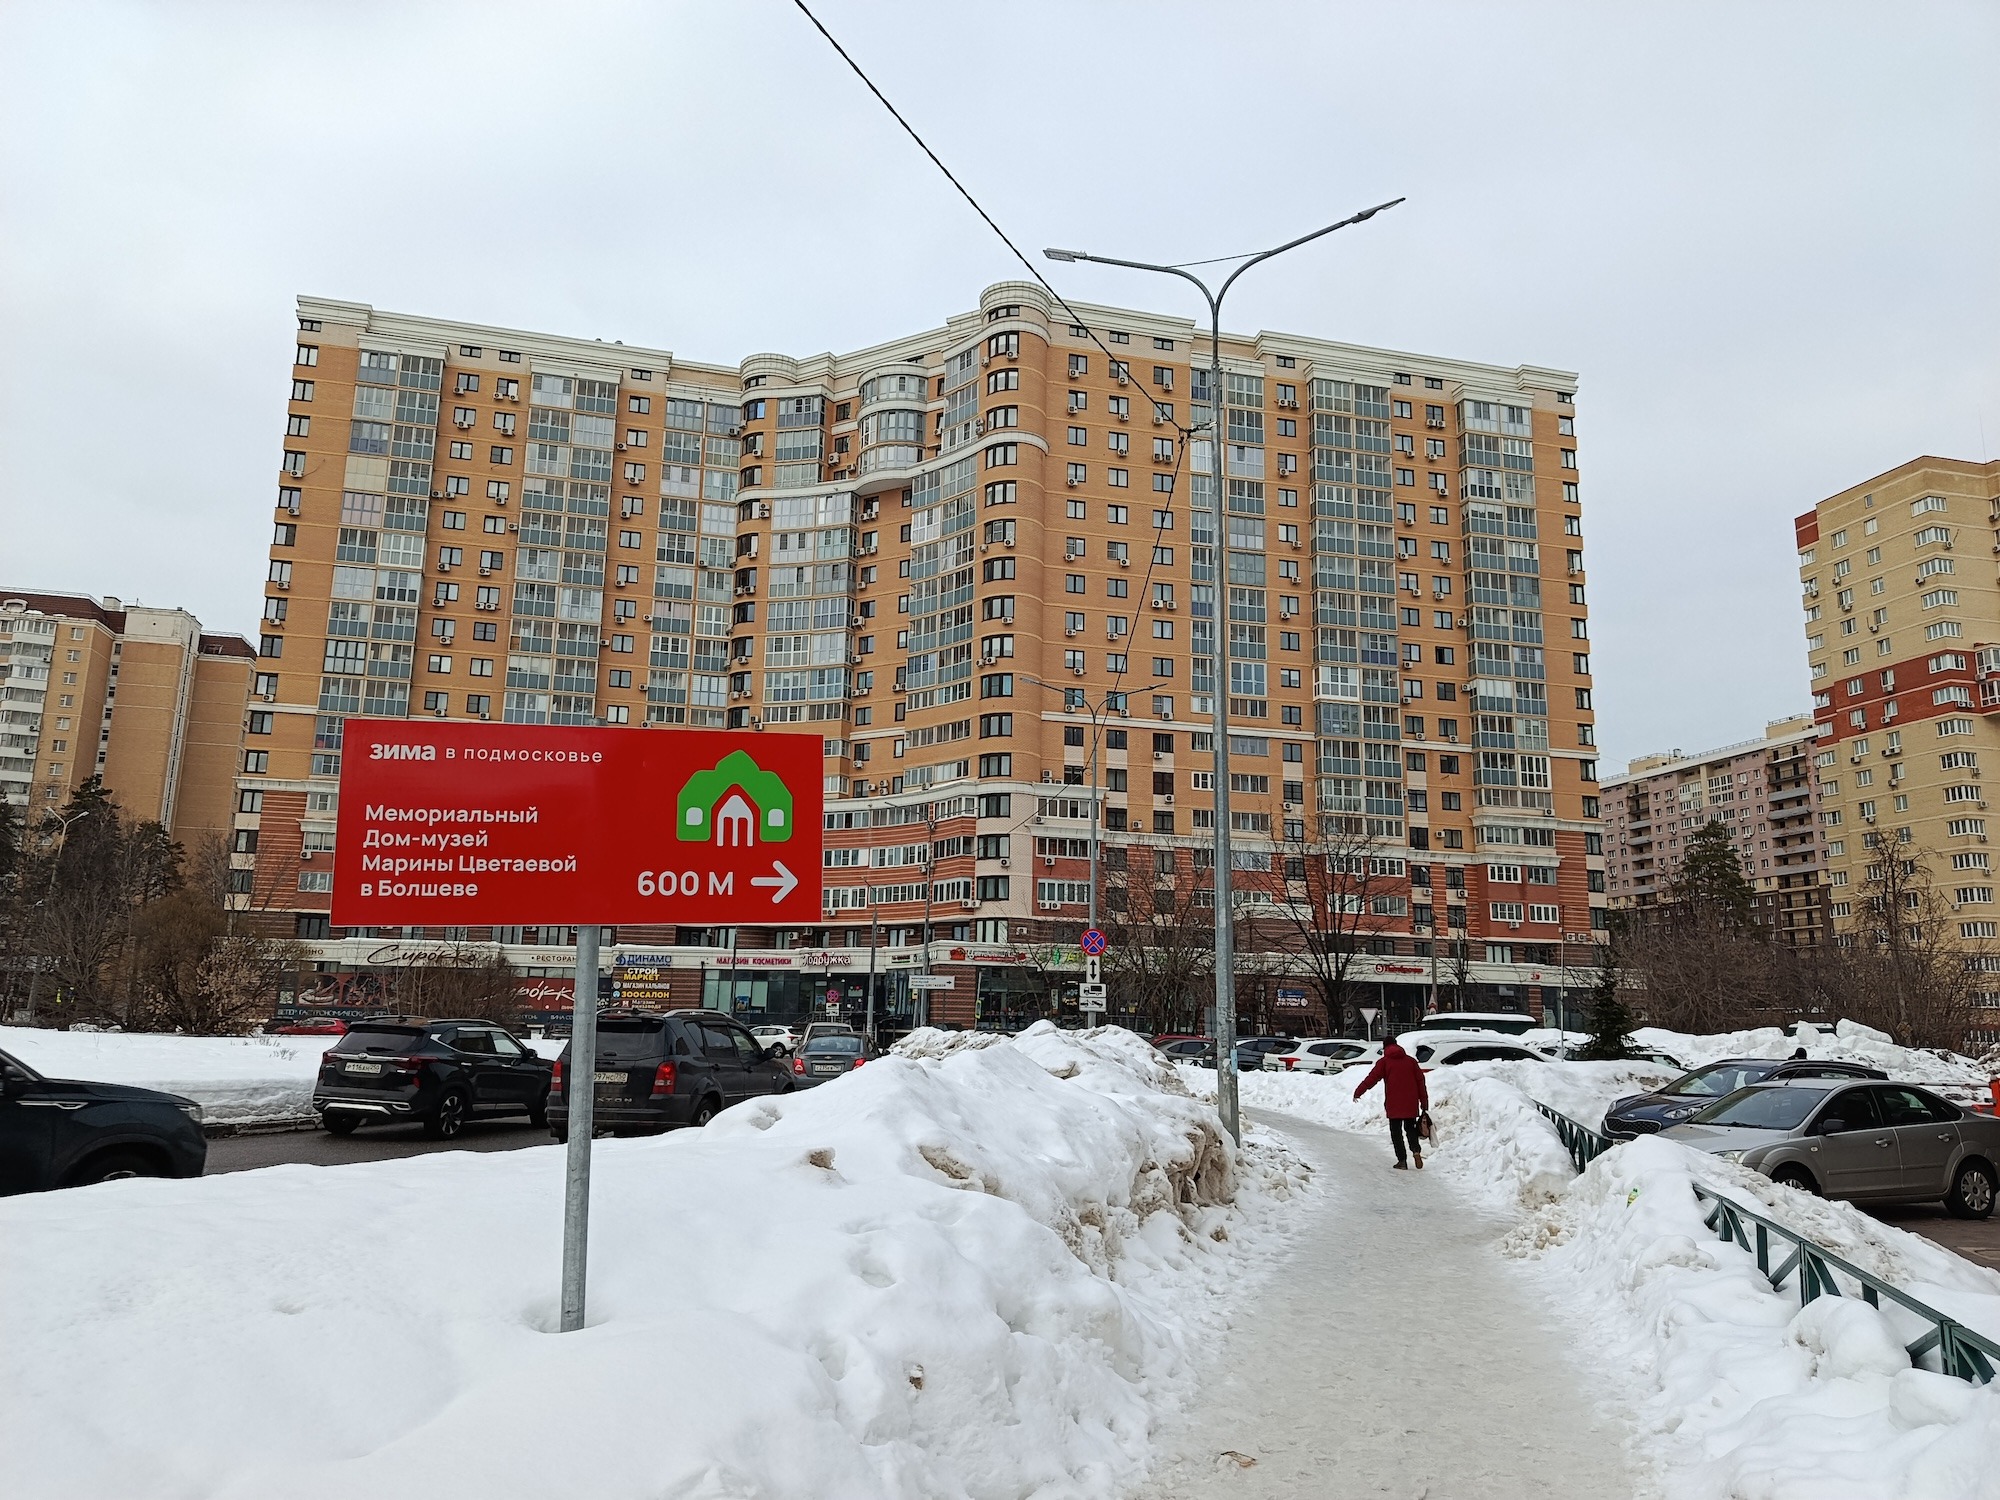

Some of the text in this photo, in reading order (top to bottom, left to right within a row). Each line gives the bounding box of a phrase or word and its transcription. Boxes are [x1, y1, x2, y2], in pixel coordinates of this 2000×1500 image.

[369, 743, 603, 763] зима в подмосковье
[365, 804, 539, 826] Мемориальный
[363, 829, 489, 851] Дом-музей
[362, 854, 577, 876] Марины Цветаевой
[360, 879, 479, 897] в Болшеве
[637, 870, 700, 897] 600
[627, 954, 672, 964] ДИНАМО
[716, 957, 792, 965] МАГАЗИН КОСМЕТИКИ
[627, 967, 658, 975] СТРОЙ
